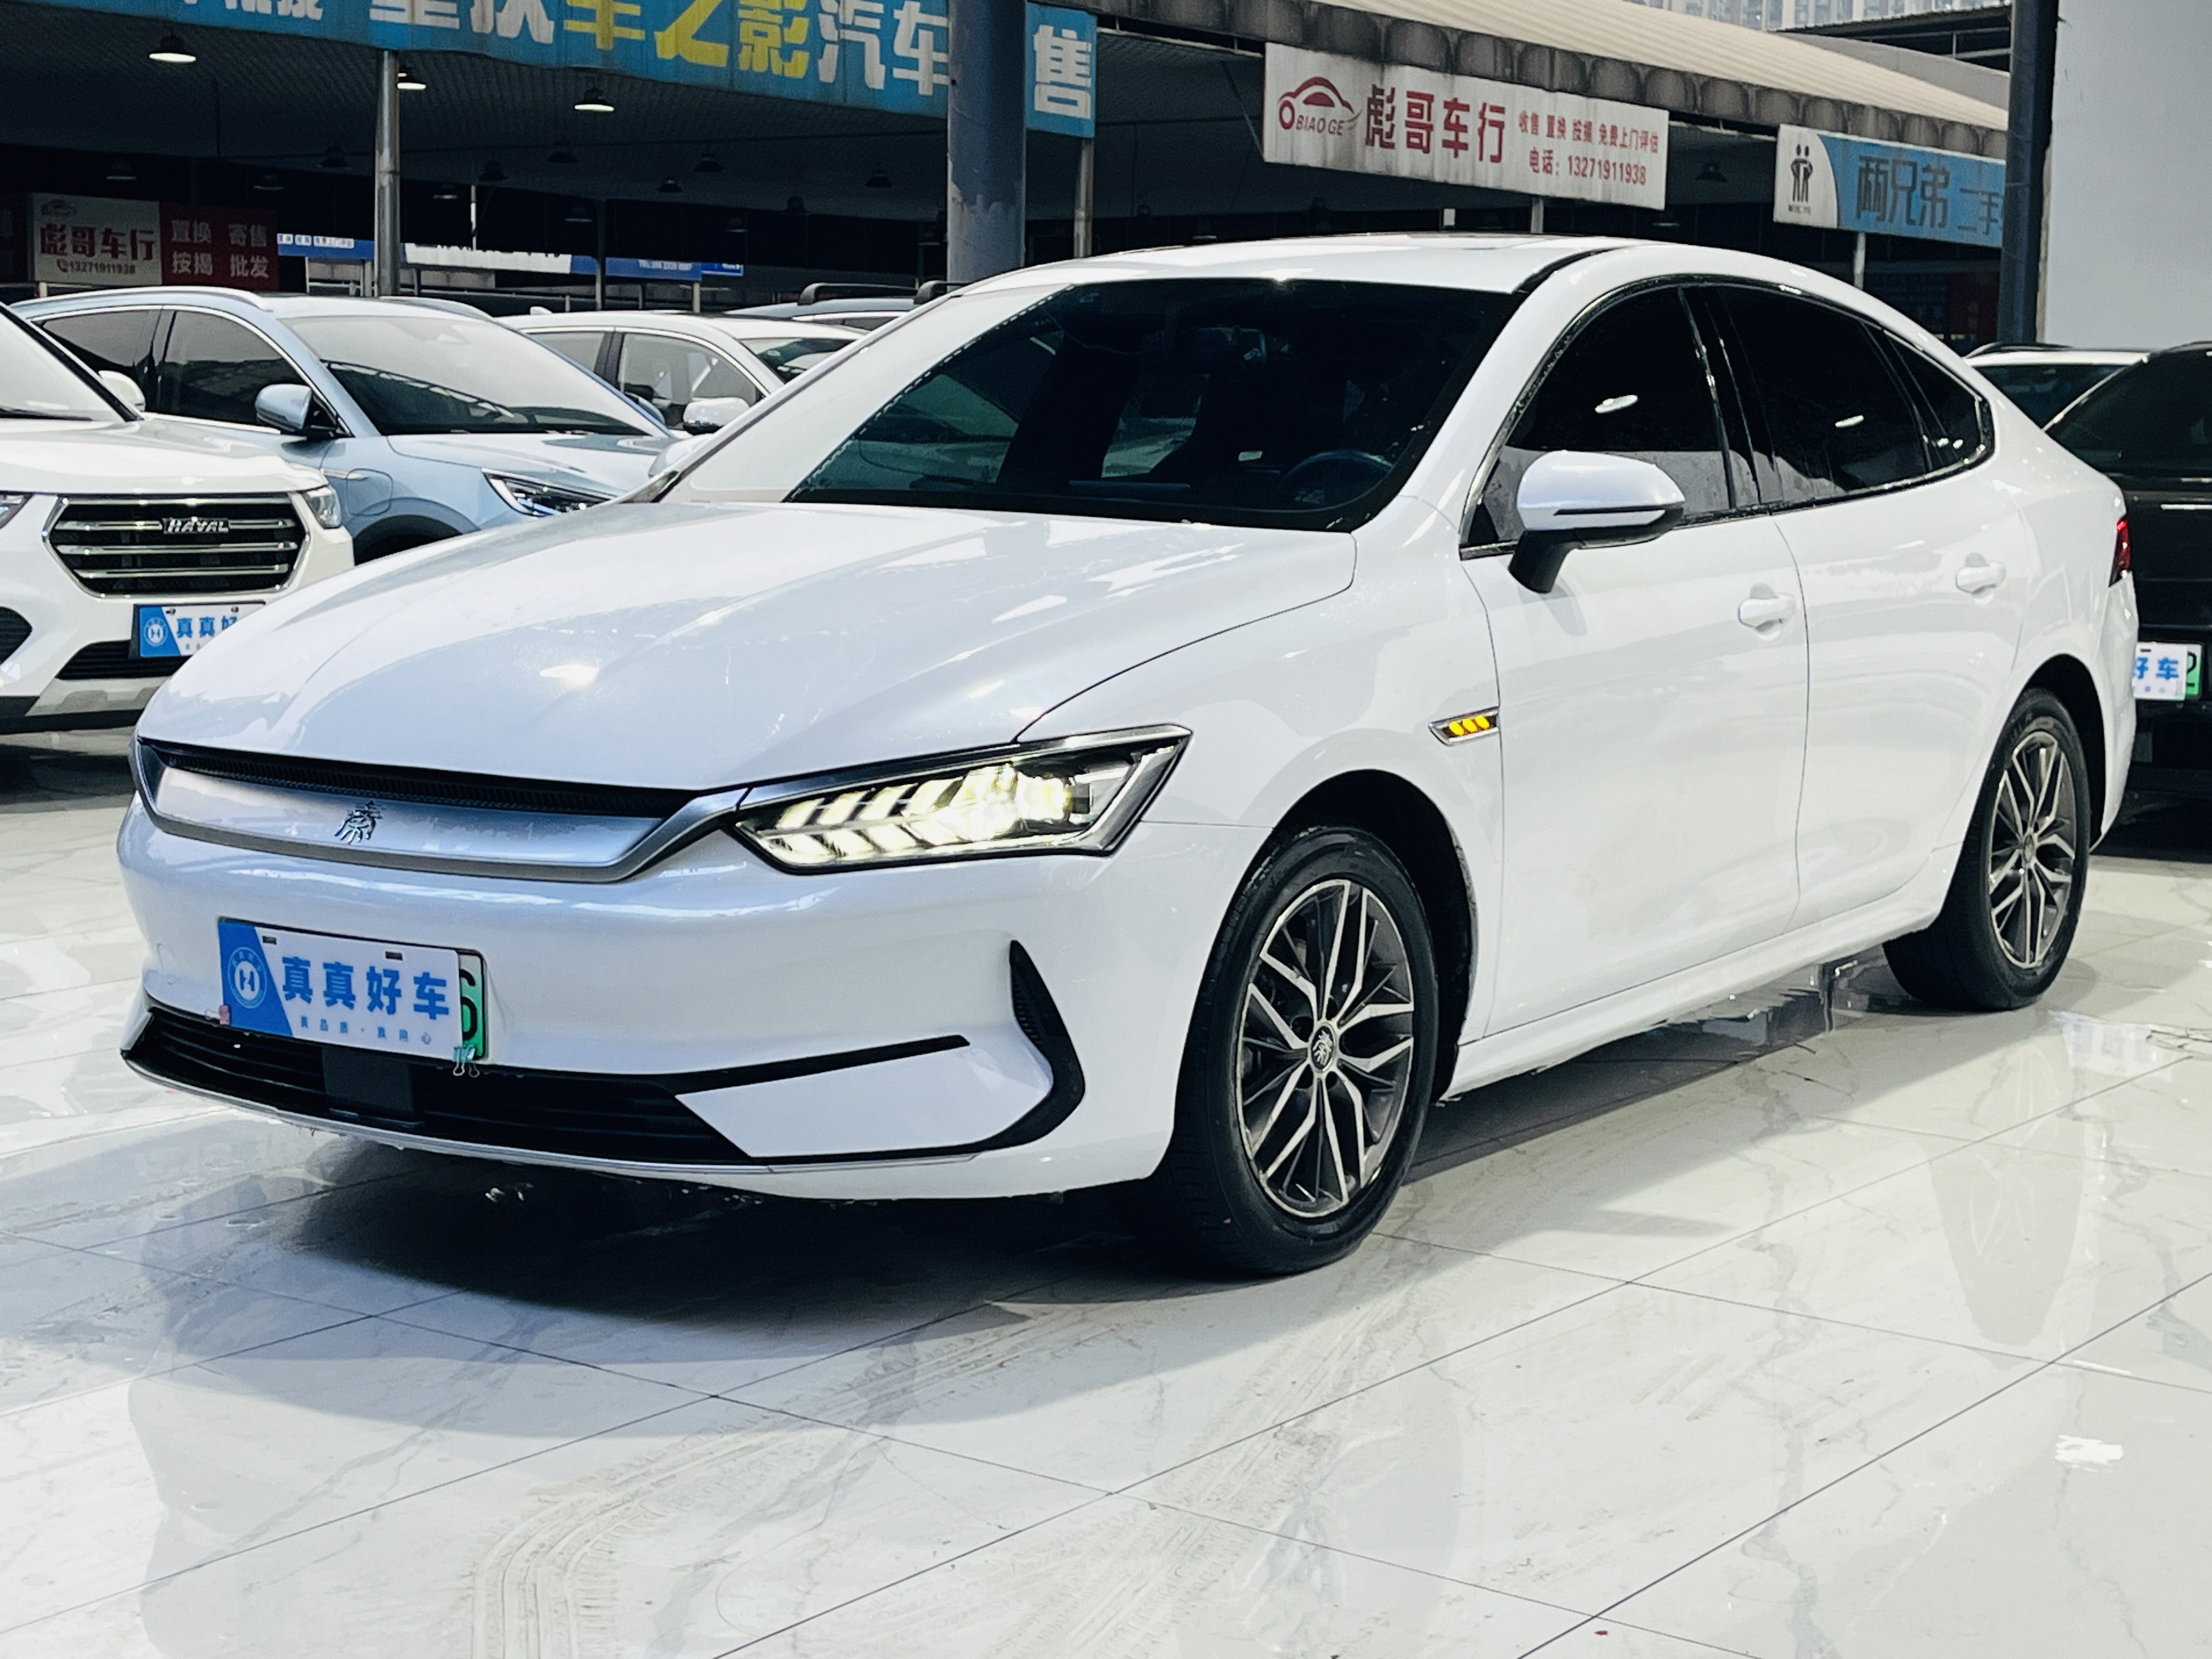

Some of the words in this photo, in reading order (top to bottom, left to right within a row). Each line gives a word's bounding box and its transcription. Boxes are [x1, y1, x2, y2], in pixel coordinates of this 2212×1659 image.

[1365, 83, 1505, 163] 彪哥车行
[41, 223, 155, 261] 彪哥车行
[230, 253, 269, 278] 批发
[282, 956, 449, 1020] 真真好车
